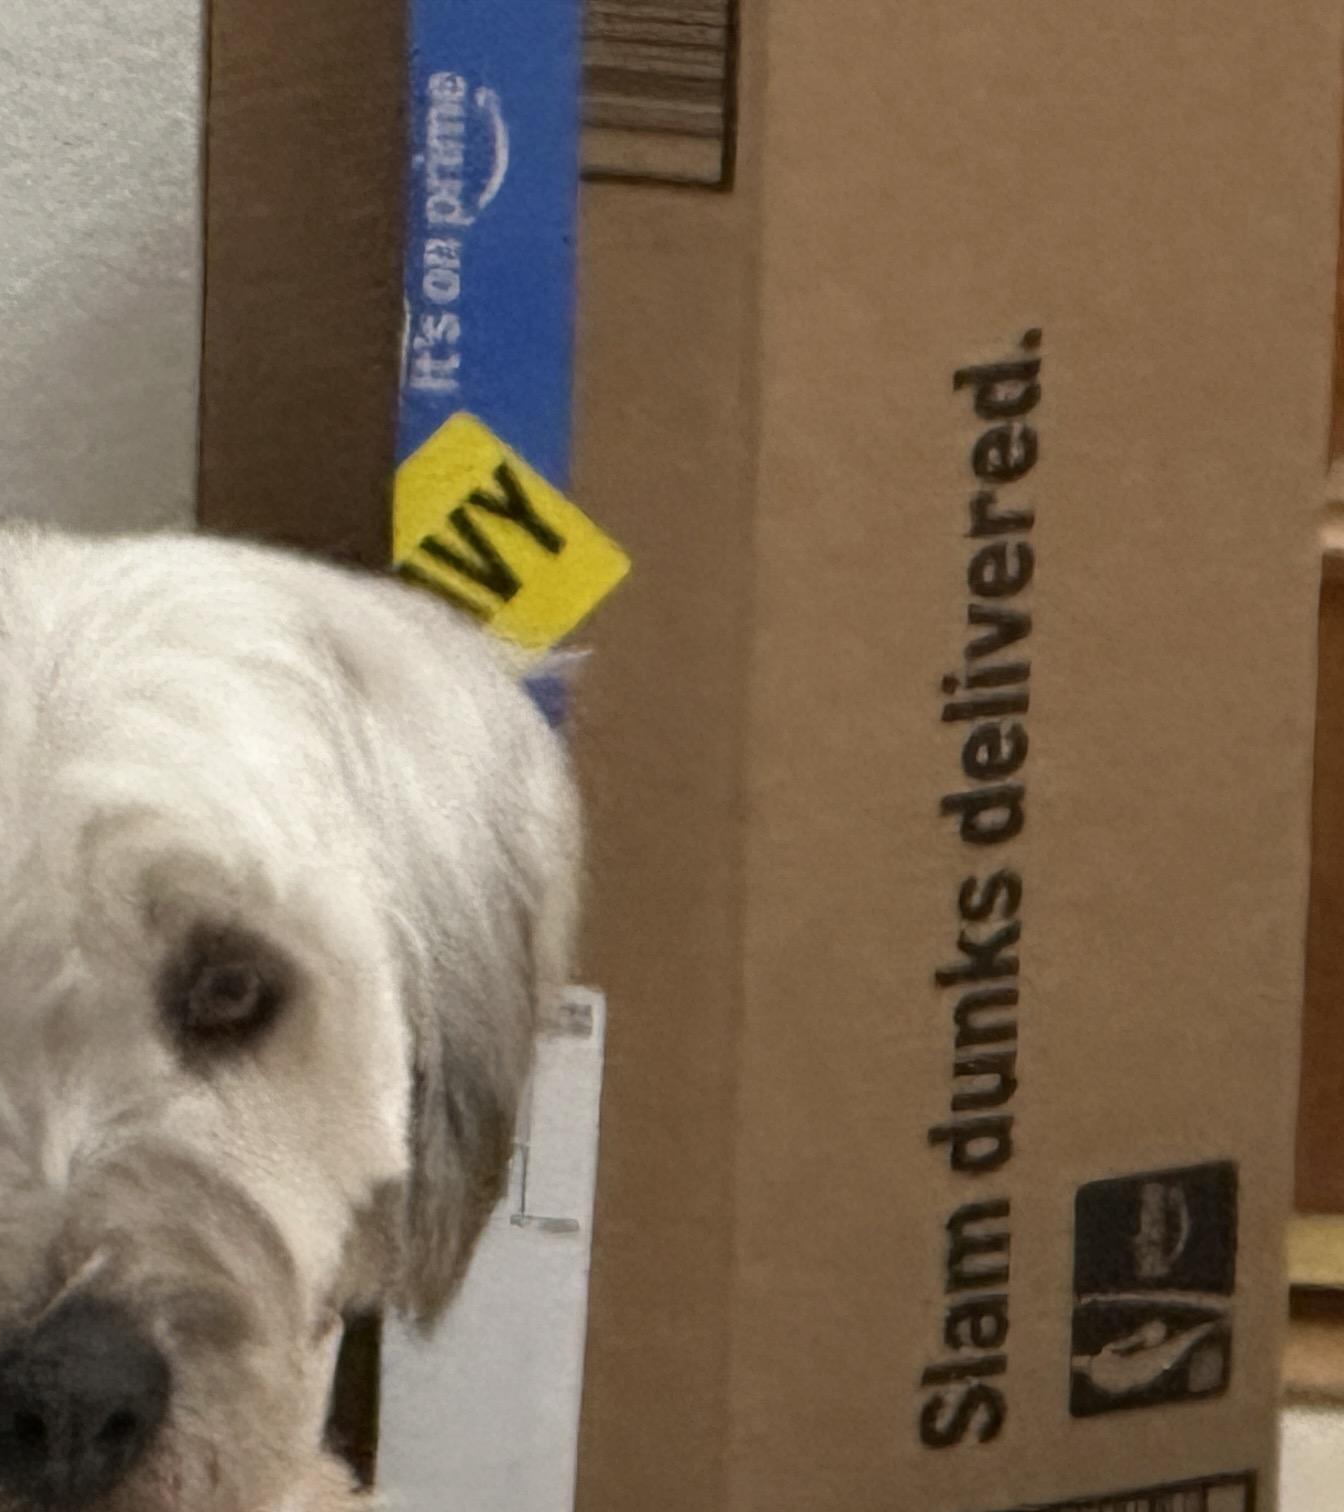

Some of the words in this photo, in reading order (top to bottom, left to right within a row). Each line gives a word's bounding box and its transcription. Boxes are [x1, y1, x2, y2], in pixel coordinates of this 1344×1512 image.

[427, 72, 475, 227] prime
[423, 239, 461, 301] on
[412, 312, 461, 391] It's
[399, 462, 566, 621] VY
[938, 327, 1043, 847] delivered.
[928, 868, 1023, 1174] dunks
[920, 1199, 1011, 1449] Slam
